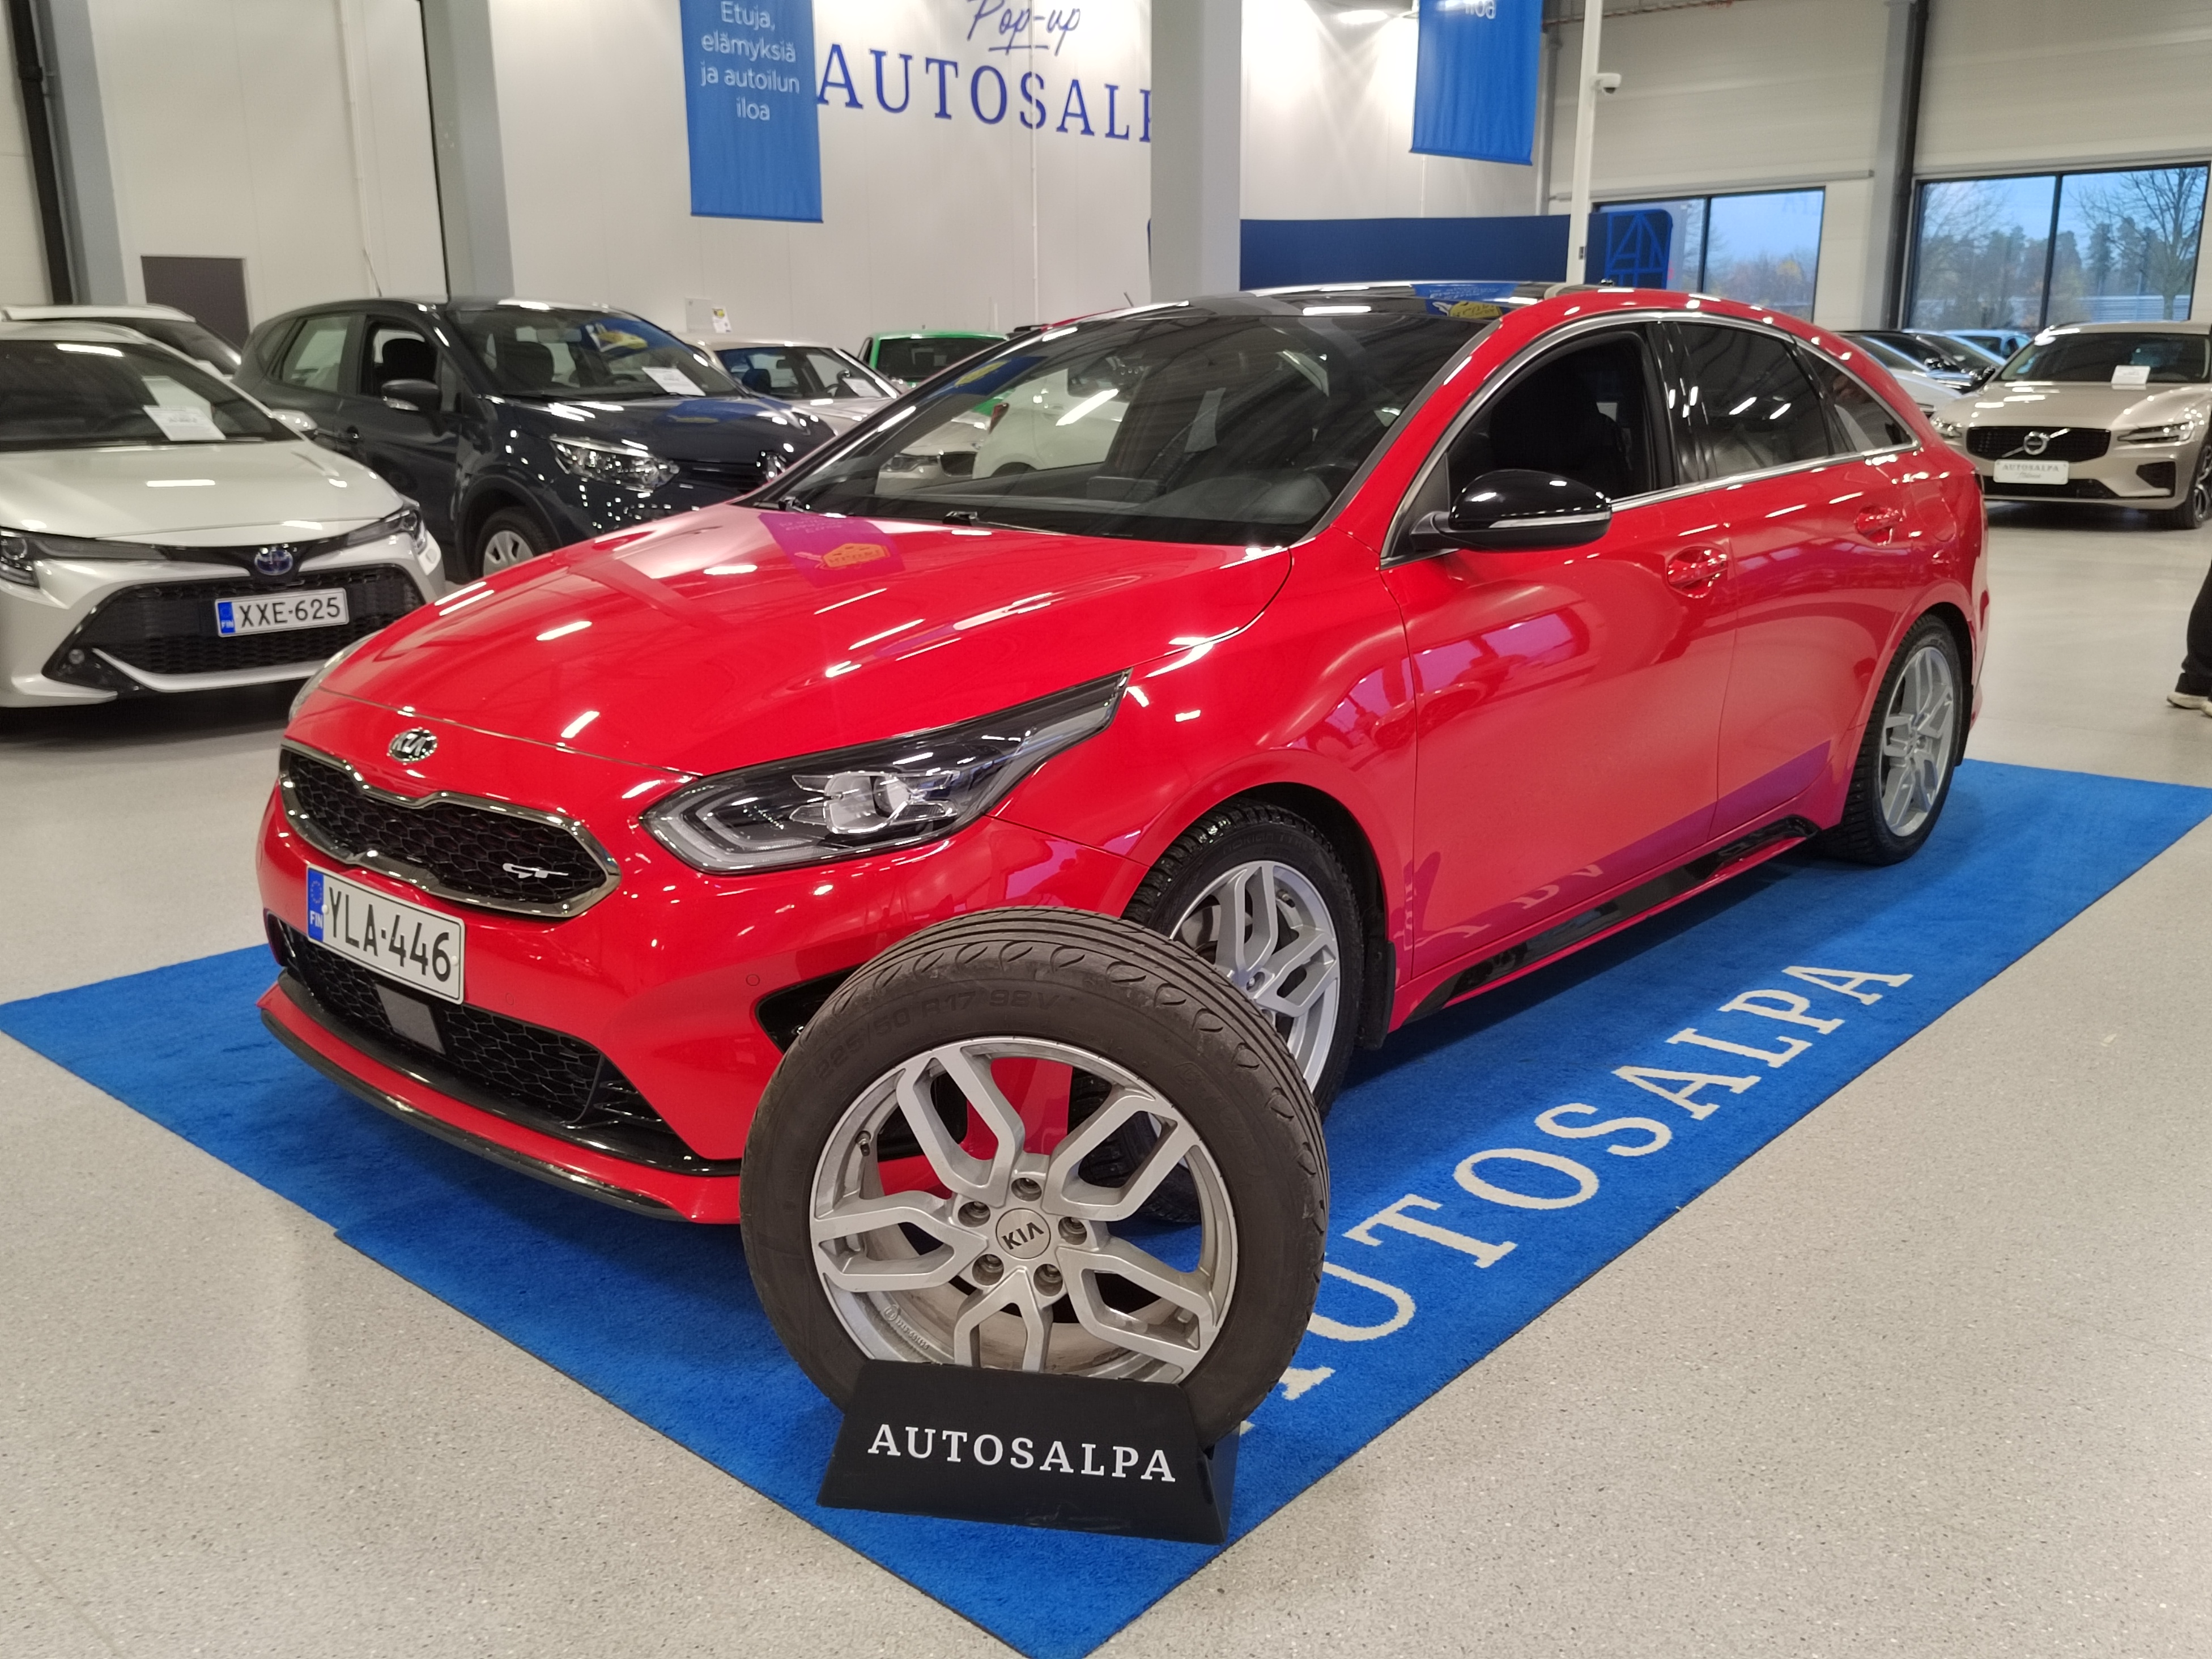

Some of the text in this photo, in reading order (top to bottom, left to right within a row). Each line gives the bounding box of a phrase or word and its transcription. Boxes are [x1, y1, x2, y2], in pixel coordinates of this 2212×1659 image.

[720, 1, 775, 31] Etuja,
[701, 29, 796, 63] elämyksiä
[700, 59, 800, 94] ja autoilun
[736, 96, 771, 121] iloa
[239, 597, 341, 628] XXE-625
[309, 909, 324, 929] FIN
[329, 886, 451, 982] YLA-446
[1239, 965, 1915, 1436] UTOSALPA
[1001, 1222, 1044, 1250] KIA
[867, 1423, 1176, 1483] AUTOSALPA
